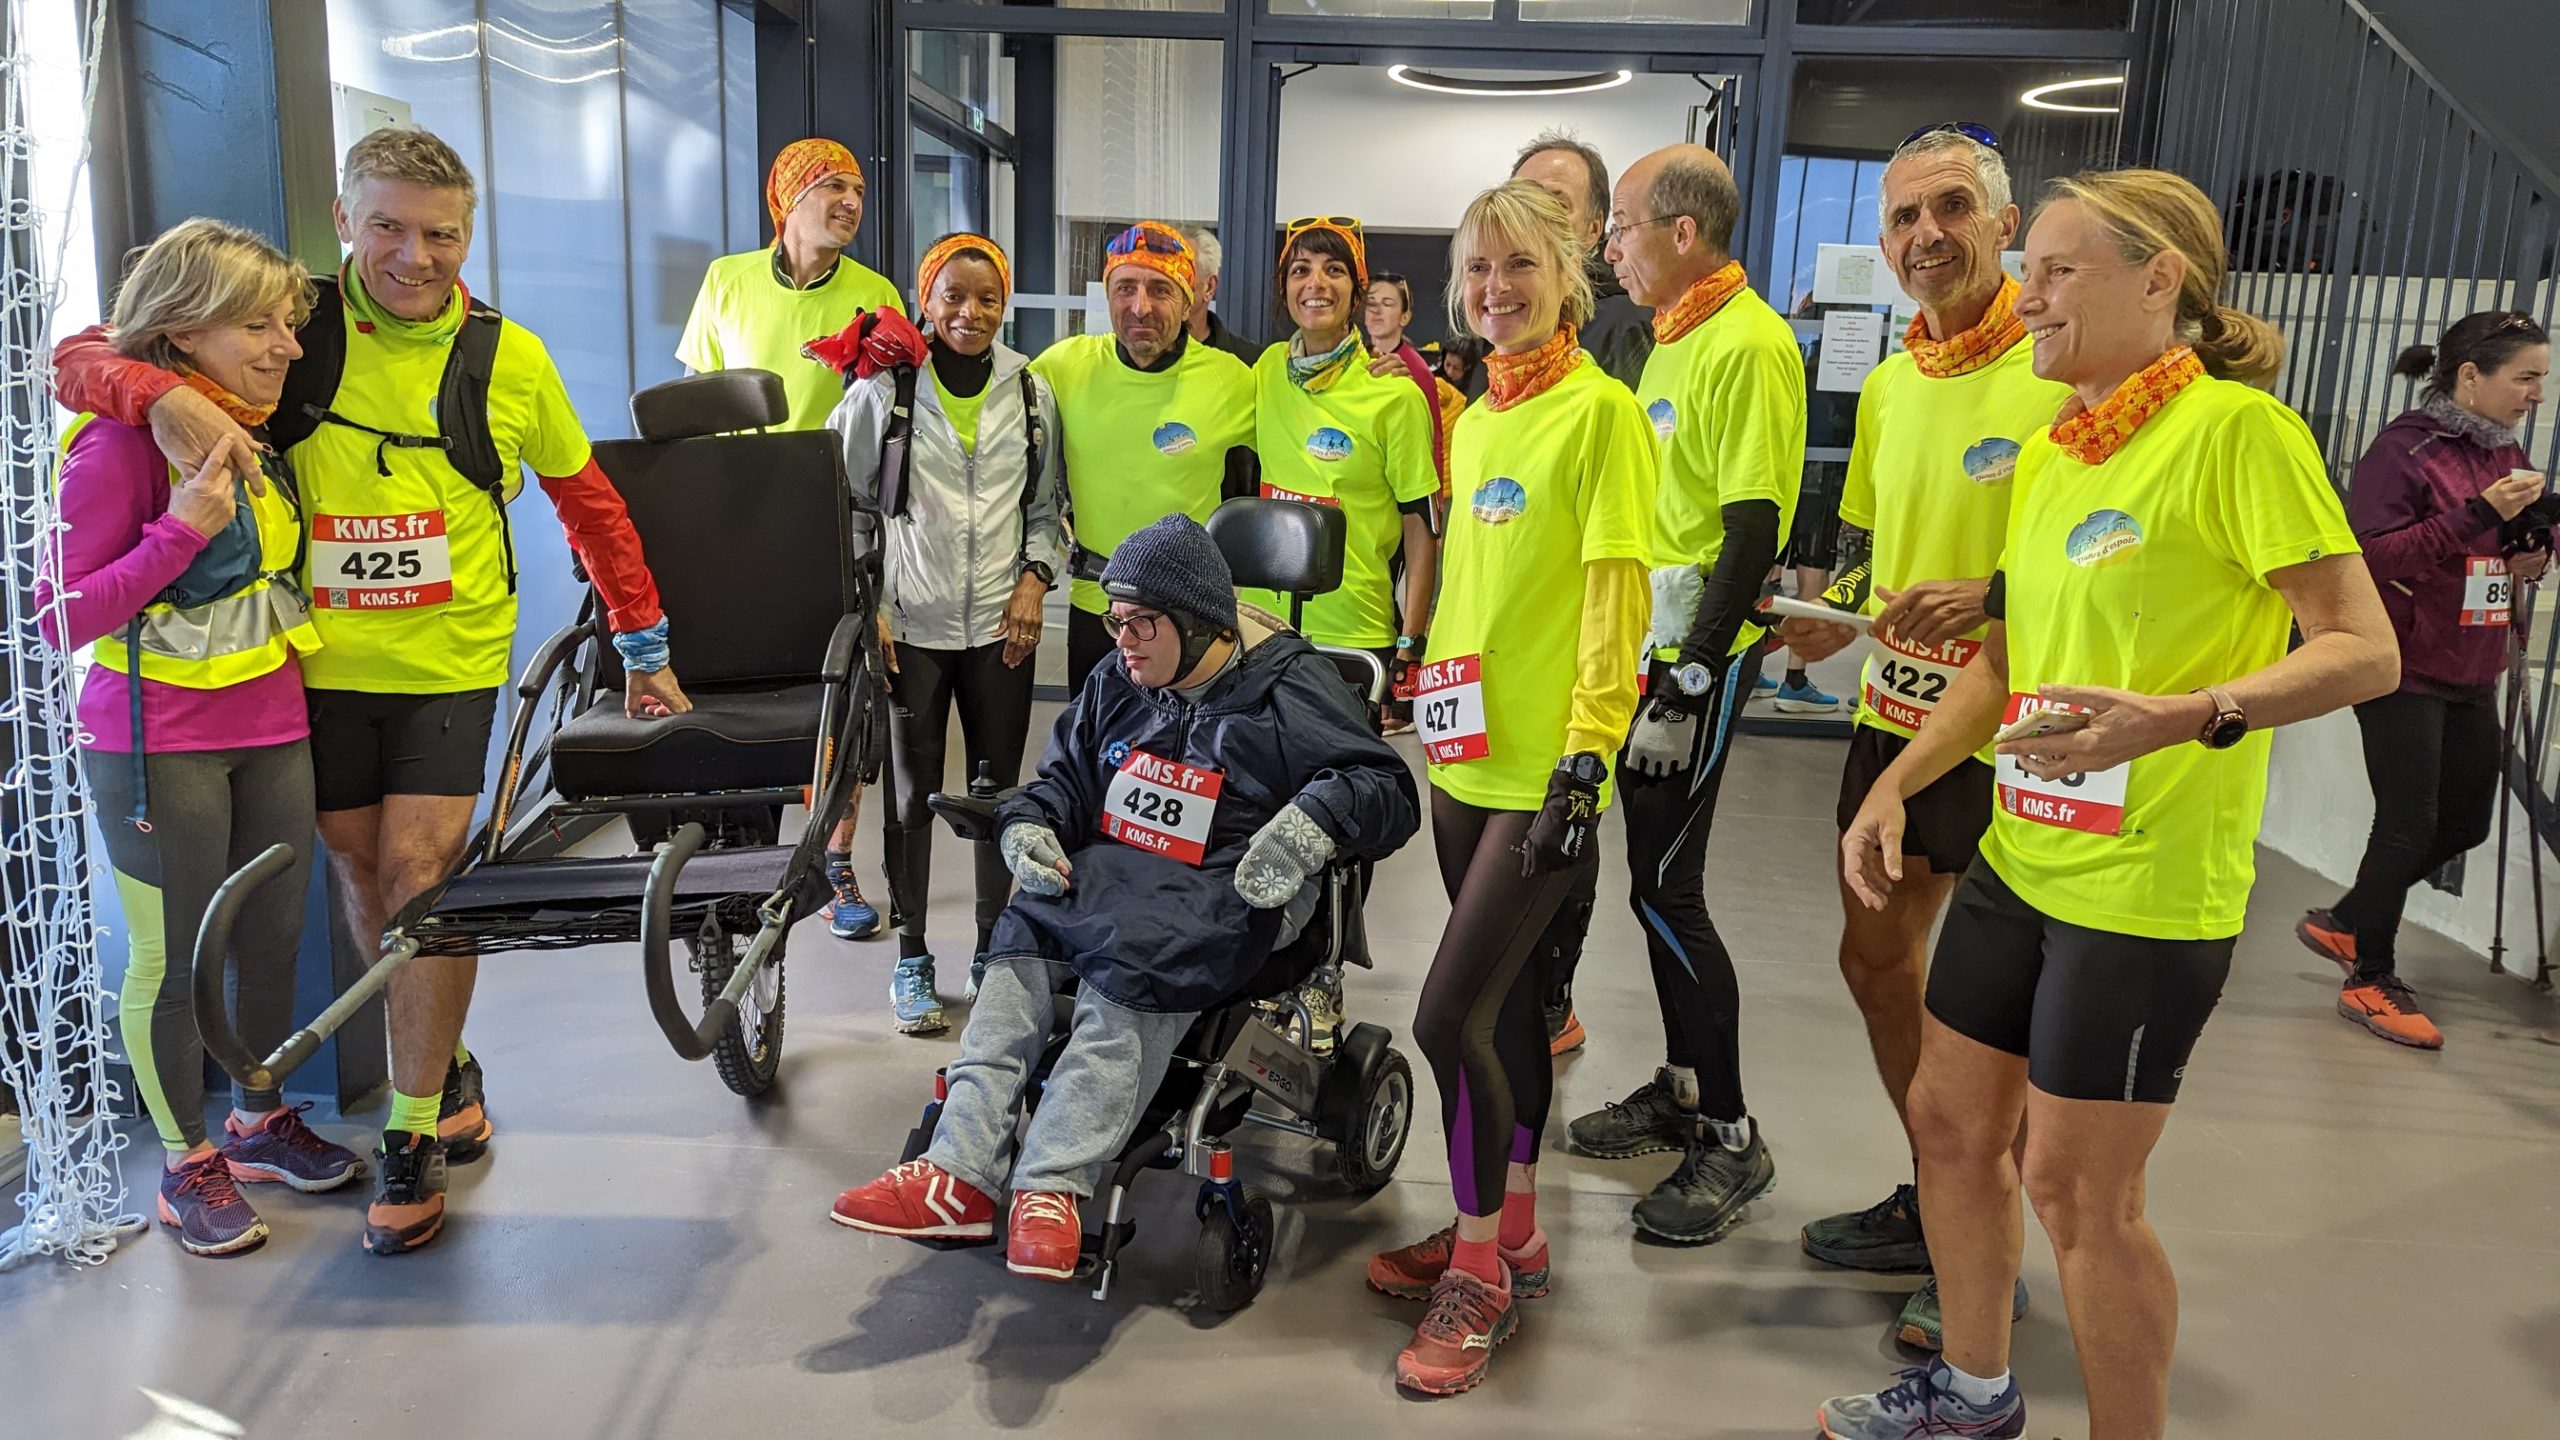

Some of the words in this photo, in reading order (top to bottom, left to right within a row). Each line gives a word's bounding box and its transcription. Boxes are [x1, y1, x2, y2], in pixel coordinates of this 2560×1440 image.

[333, 515, 429, 539] KMS.fr
[2102, 535, 2137, 555] d'espoir
[341, 549, 422, 580] 425
[360, 590, 420, 606] KMS.fr
[1419, 659, 1465, 692] KMS.fr
[1881, 660, 1948, 703] 422
[1425, 697, 1460, 733] 427
[1885, 702, 1929, 728] KMS.f
[1438, 742, 1464, 760] KMS.fr
[1132, 753, 1205, 791] KMS.fr
[1123, 787, 1184, 827] 428
[2022, 796, 2076, 823] KMS.fr
[1125, 826, 1171, 851] KMS.fr
[1267, 1070, 1293, 1092] ERGO
